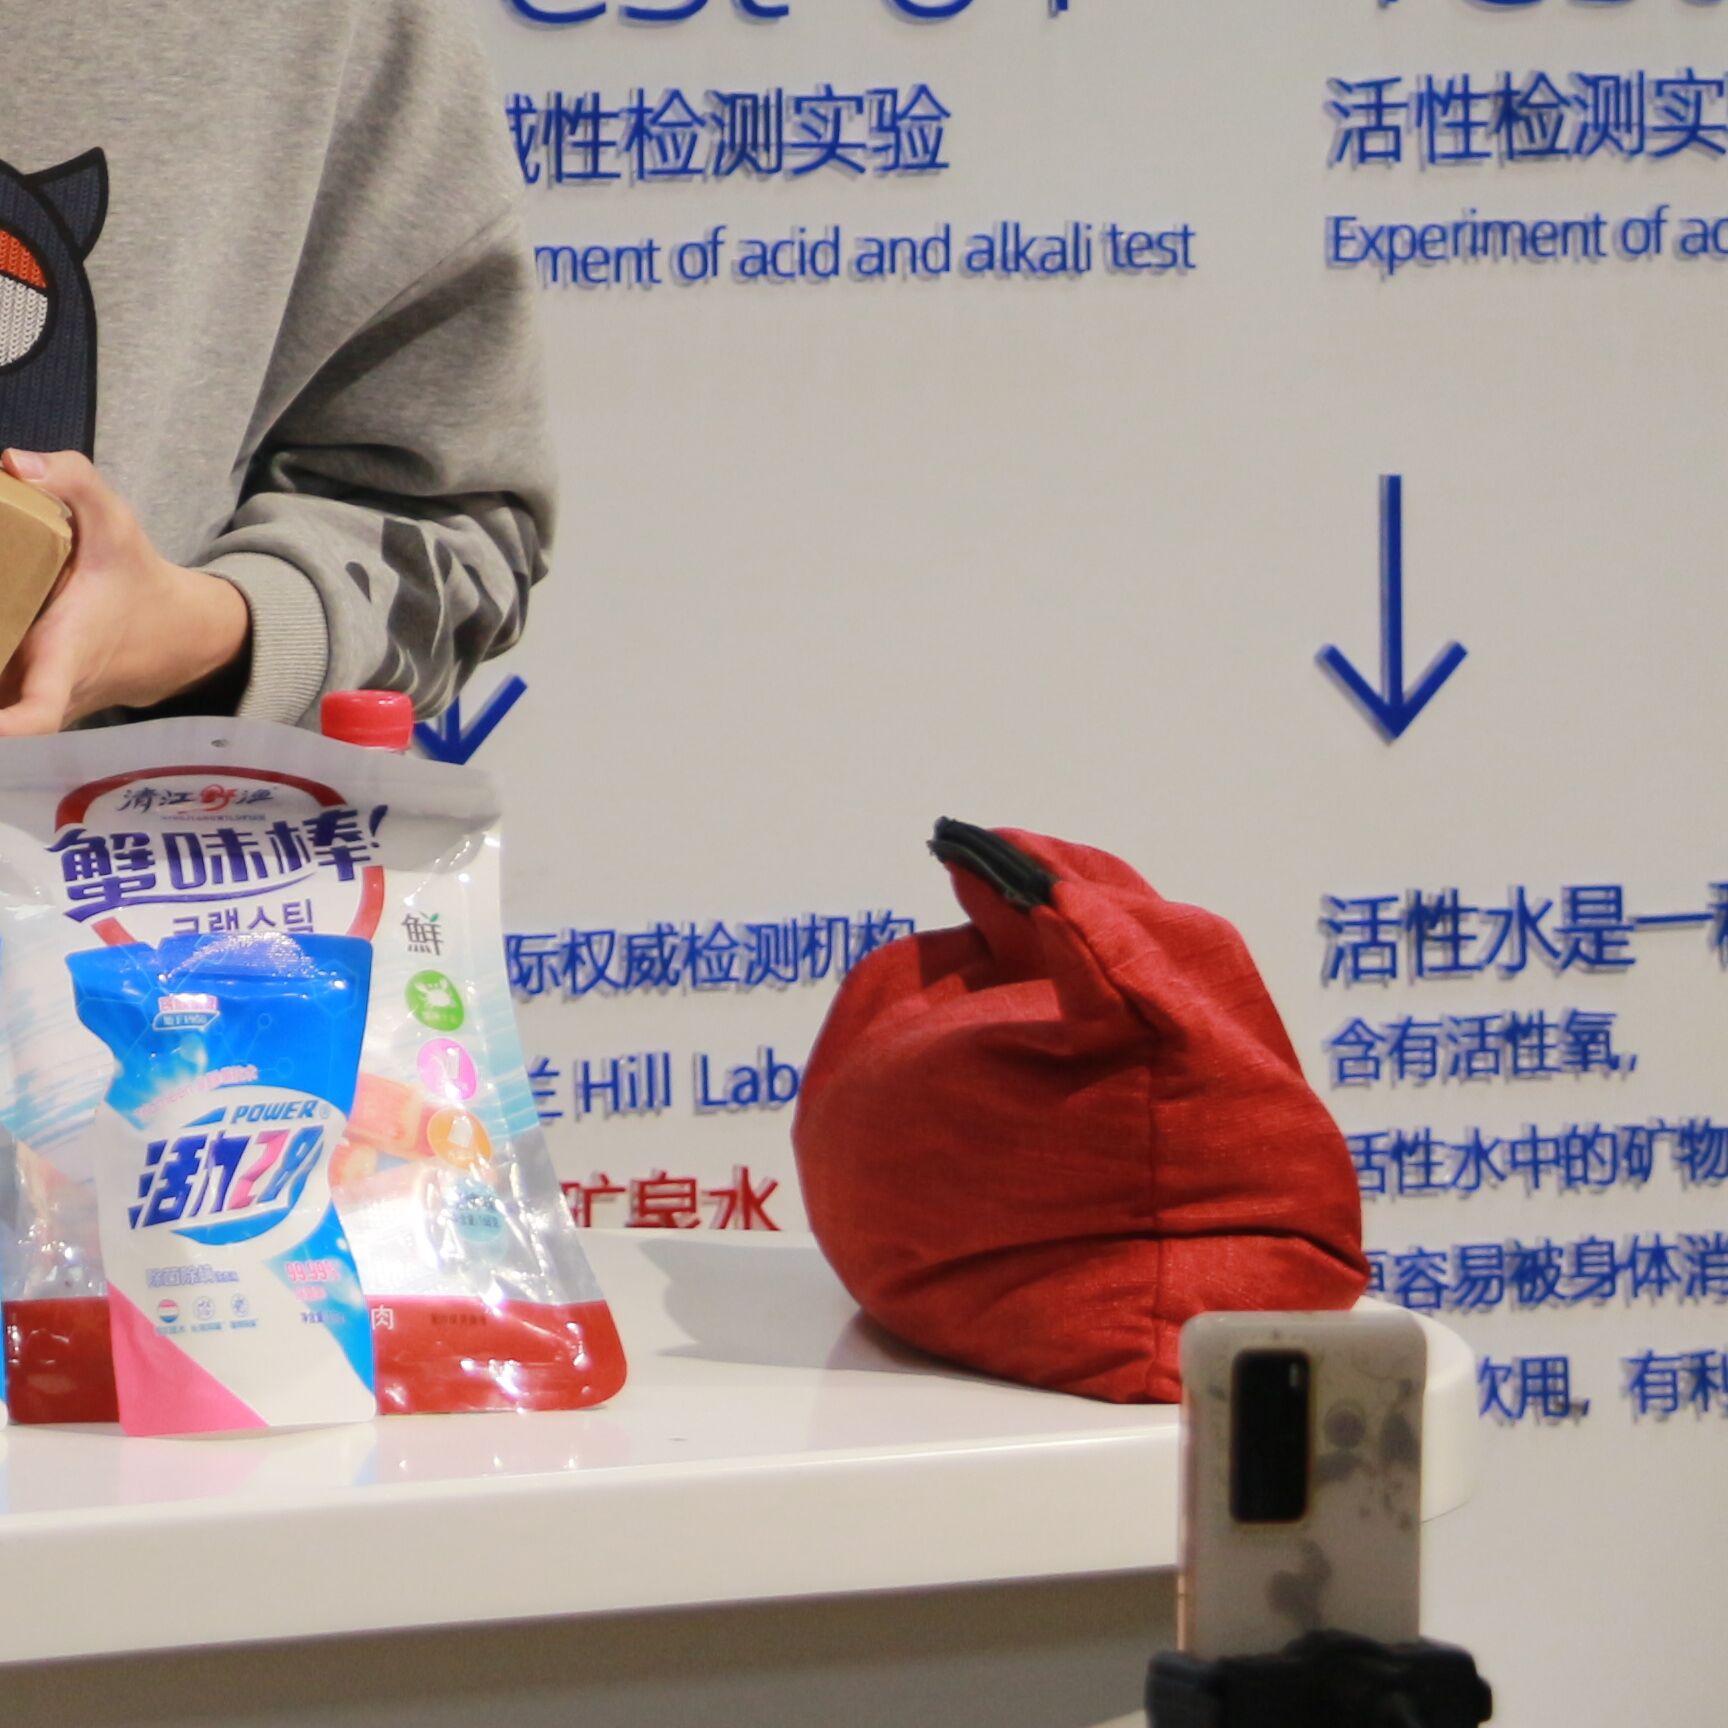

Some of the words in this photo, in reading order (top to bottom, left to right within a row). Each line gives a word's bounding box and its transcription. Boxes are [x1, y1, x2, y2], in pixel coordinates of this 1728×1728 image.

[676, 224, 727, 282] of
[741, 223, 842, 281] acid
[856, 223, 953, 278] and
[966, 218, 1093, 275] alkali
[1107, 220, 1198, 272] test
[1329, 206, 1607, 276] Experiment
[1621, 204, 1670, 256] of
[1321, 881, 1728, 983] 活性水是一
[230, 1099, 319, 1126] POWER
[580, 1051, 671, 1114] Hill
[127, 1125, 325, 1232] 活力28
